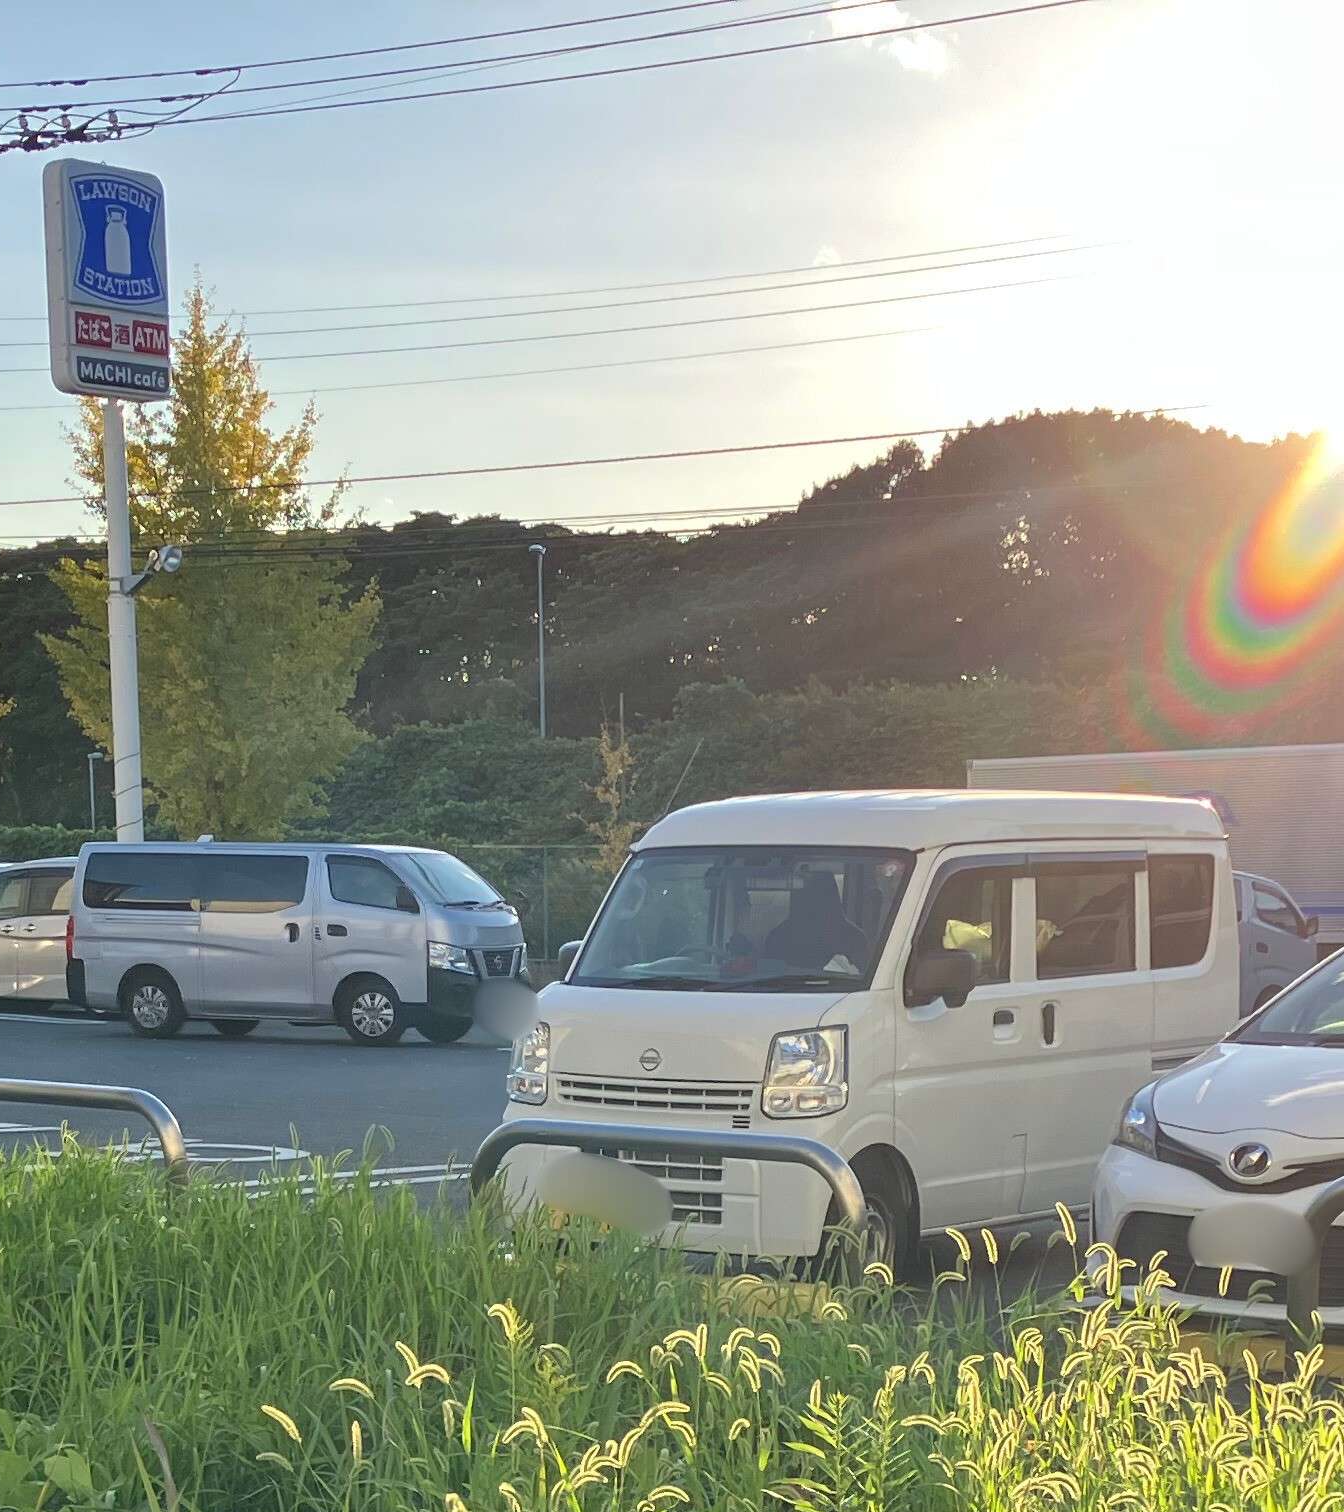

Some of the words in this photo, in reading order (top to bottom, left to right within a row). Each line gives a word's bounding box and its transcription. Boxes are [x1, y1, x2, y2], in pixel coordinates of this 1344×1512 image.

[78, 183, 153, 214] LAWSON
[83, 267, 155, 297] STATION
[77, 317, 112, 343] たばこ
[133, 327, 167, 351] ATM
[80, 361, 132, 384] MACHI
[134, 368, 166, 388] café
